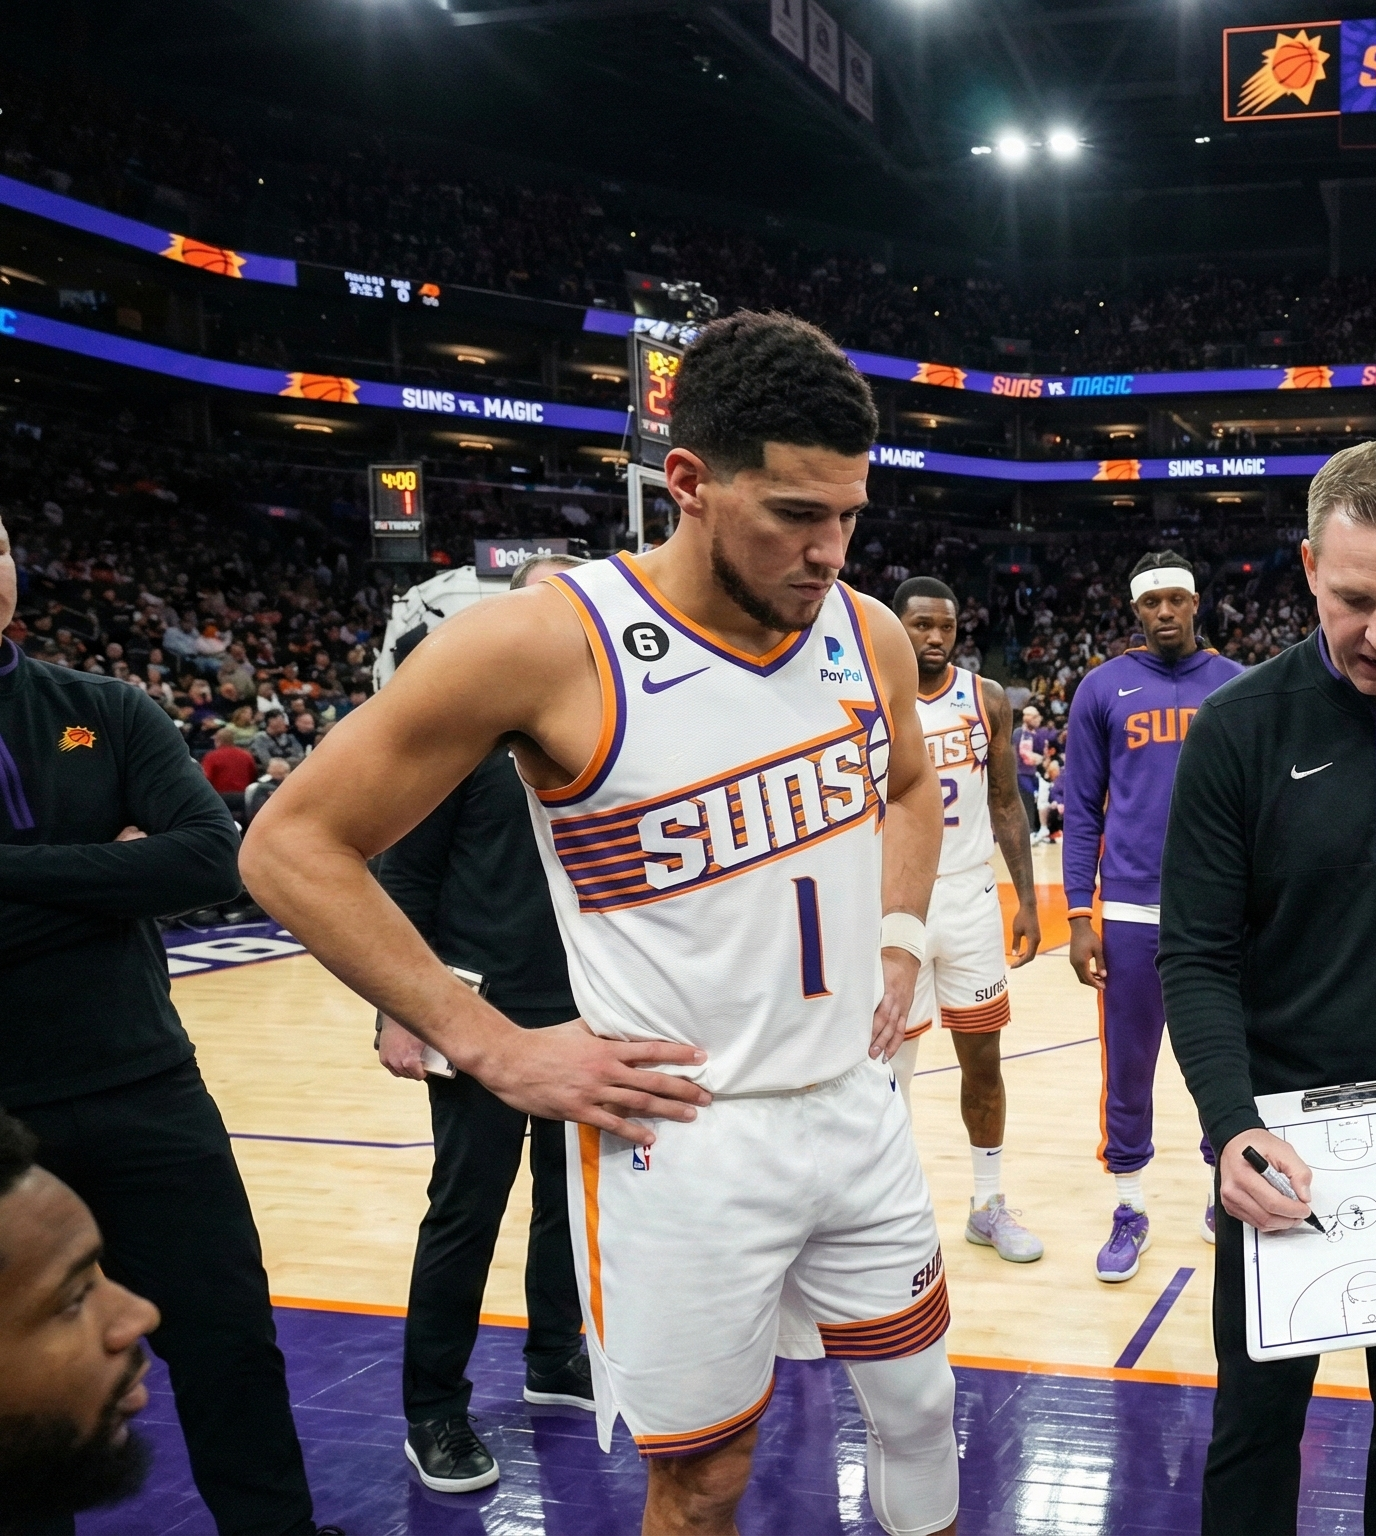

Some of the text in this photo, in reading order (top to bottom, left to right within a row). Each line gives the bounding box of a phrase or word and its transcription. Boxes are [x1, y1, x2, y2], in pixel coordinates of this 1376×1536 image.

[991, 375, 1043, 398] SUNS
[1071, 374, 1134, 397] MAGIC
[402, 387, 455, 413] SUNS
[484, 397, 544, 423] MAGIC
[880, 447, 925, 468] MAGIC
[1168, 460, 1204, 477] SUNS
[1222, 458, 1266, 476] MAGIC
[632, 628, 659, 656] 6
[637, 739, 867, 890] SUNS
[791, 876, 833, 1000] 1
